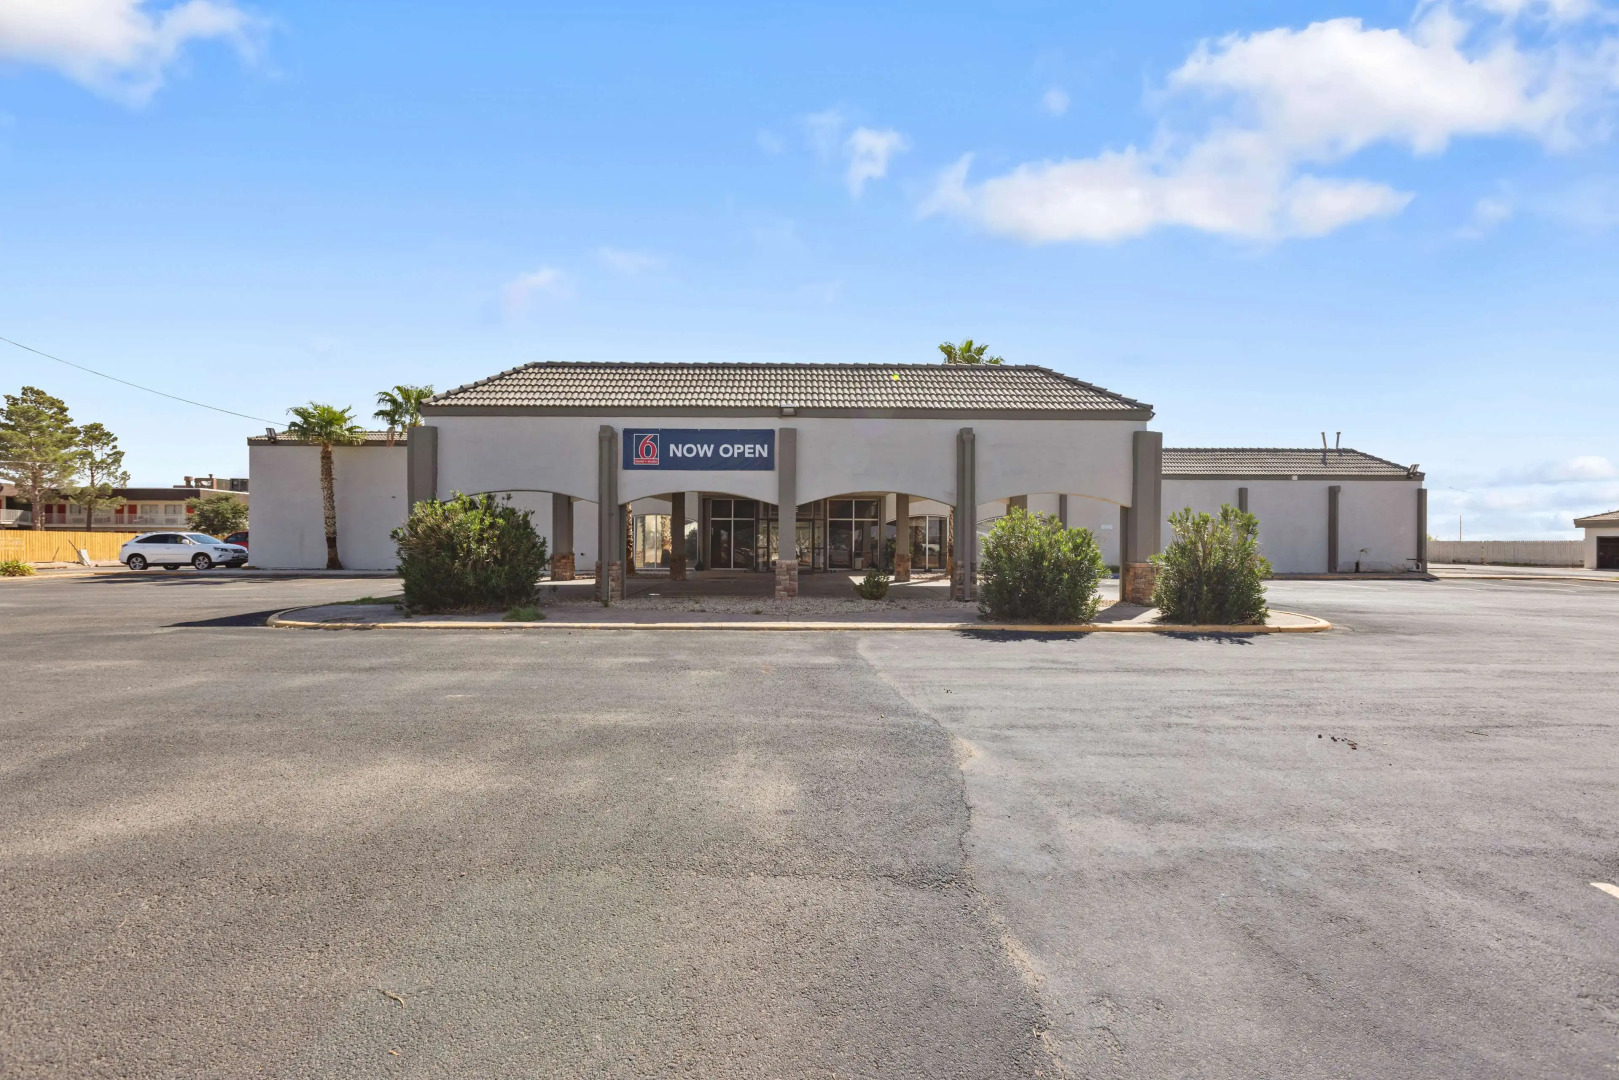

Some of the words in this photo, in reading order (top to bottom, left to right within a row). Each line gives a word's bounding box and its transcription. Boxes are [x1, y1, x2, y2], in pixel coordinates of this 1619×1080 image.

[639, 434, 657, 459] 6
[669, 443, 714, 458] NOW
[719, 443, 768, 458] OPEN
